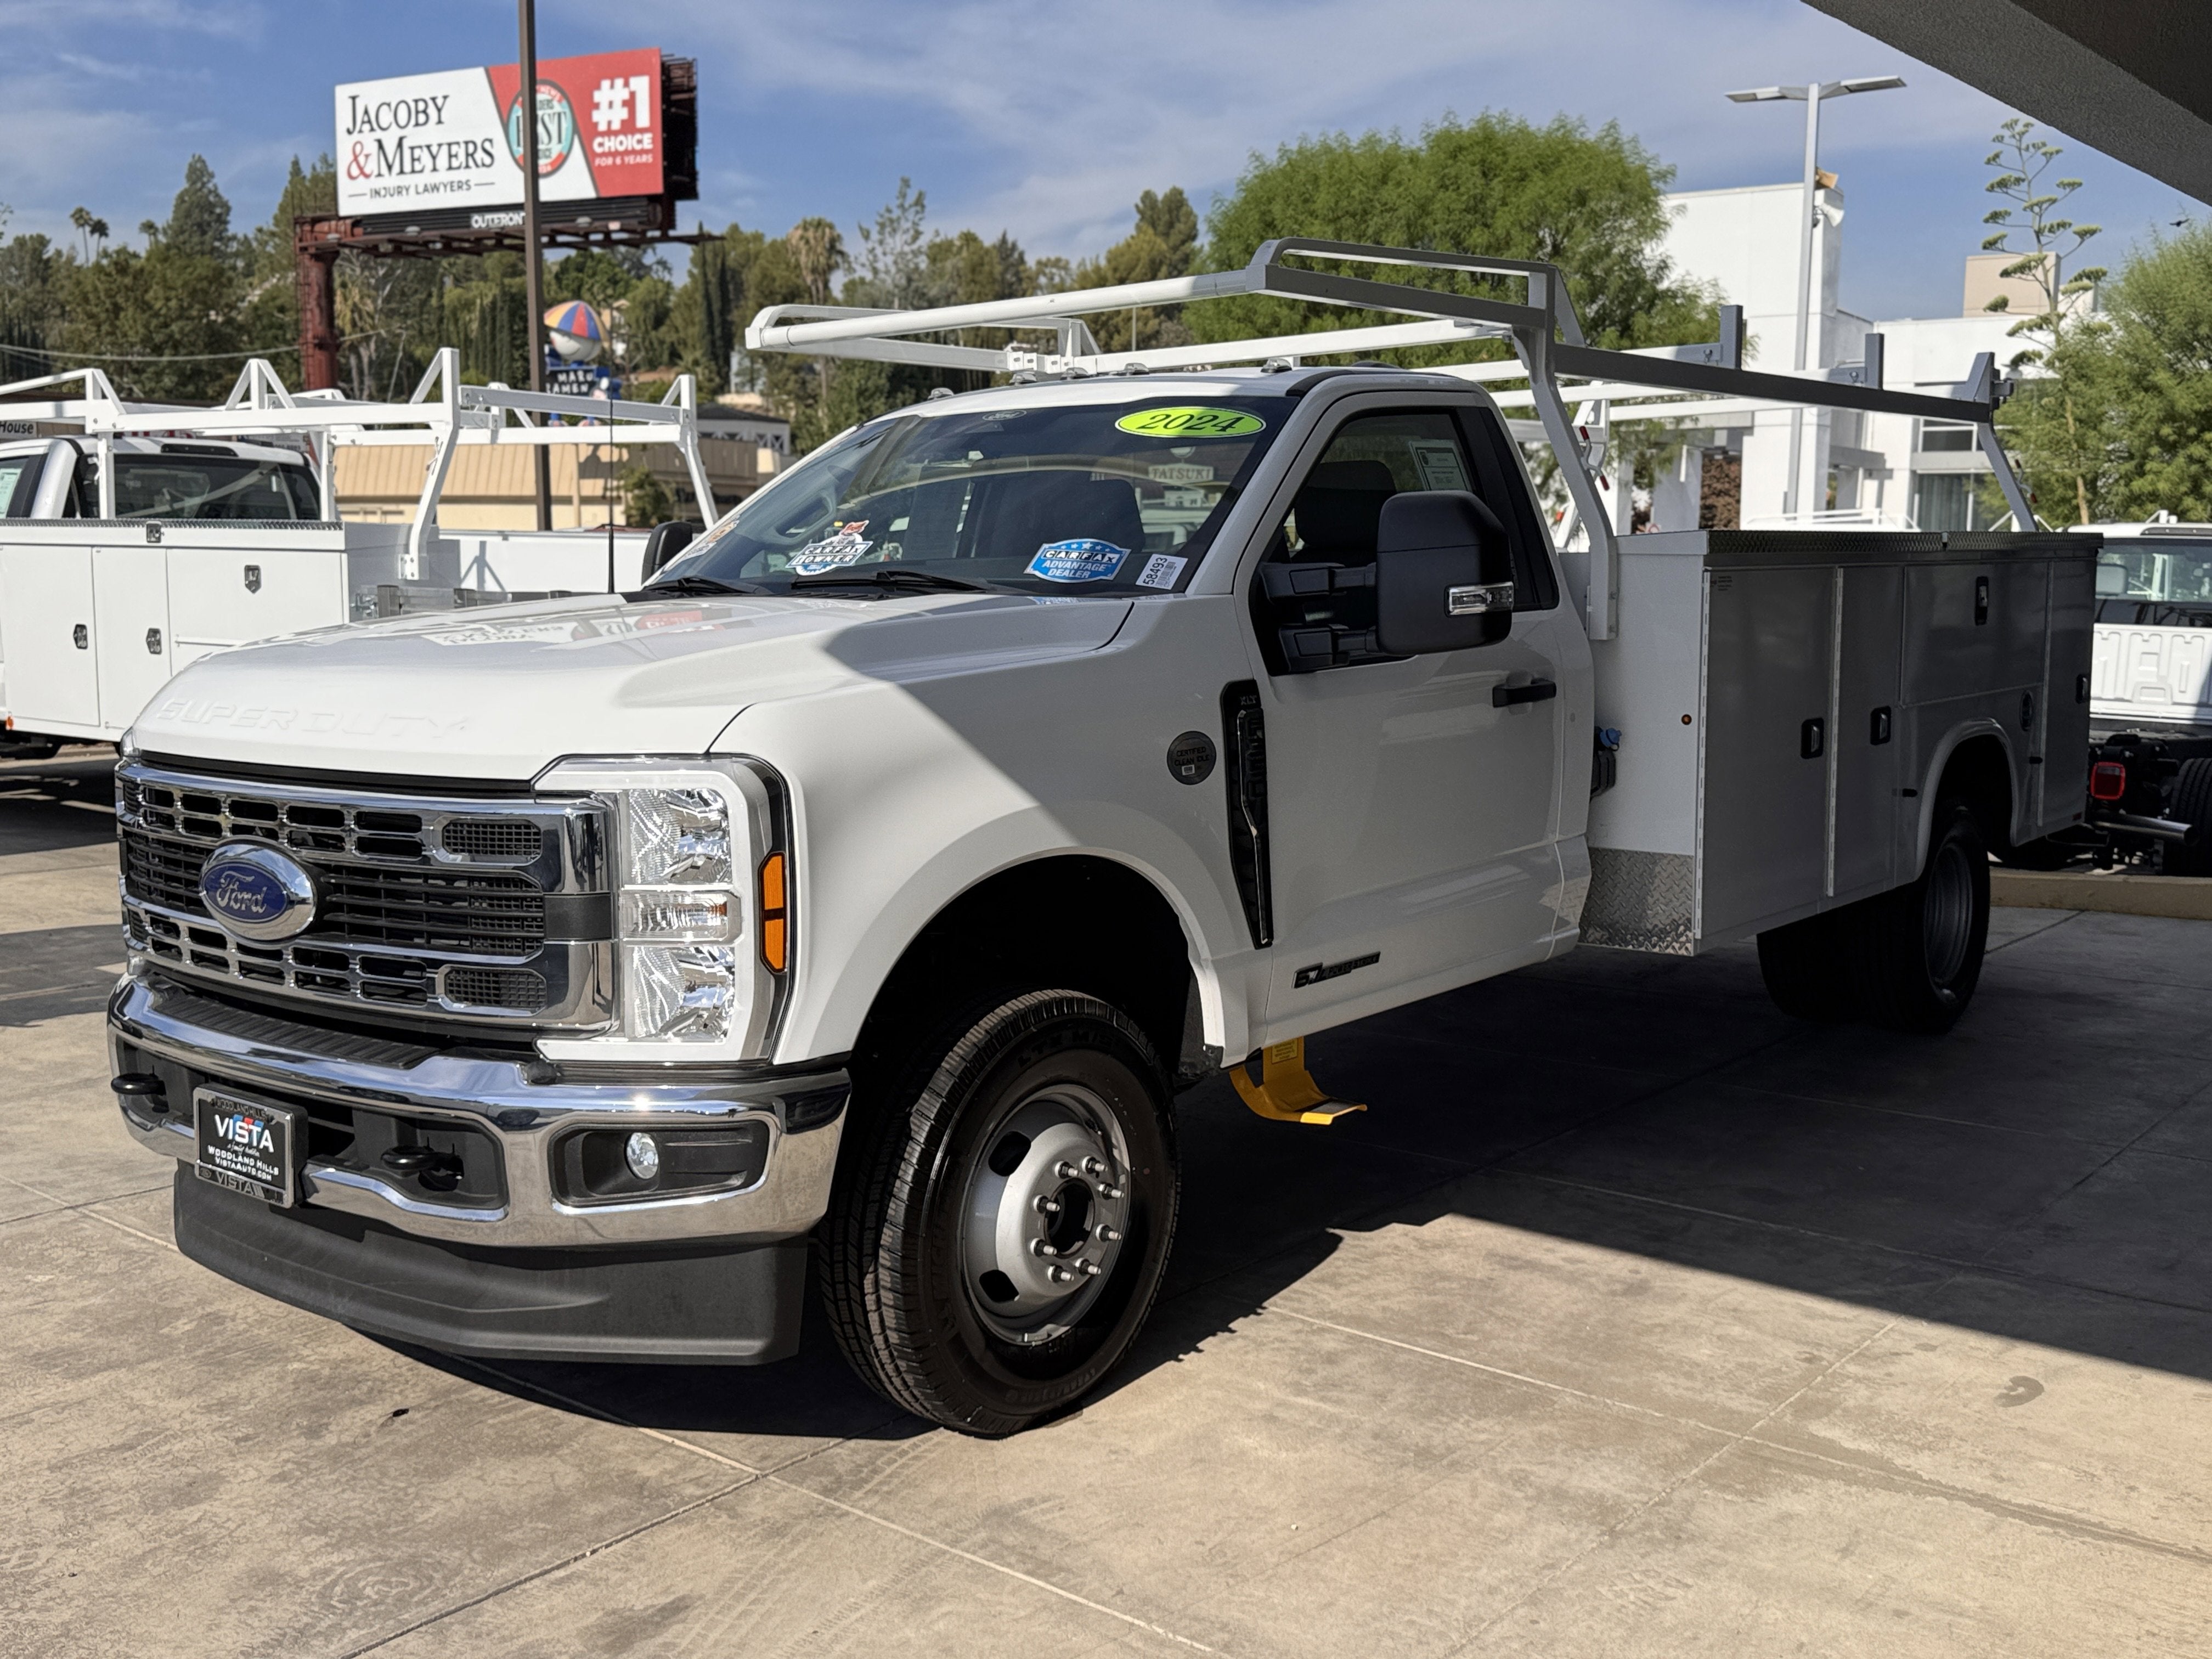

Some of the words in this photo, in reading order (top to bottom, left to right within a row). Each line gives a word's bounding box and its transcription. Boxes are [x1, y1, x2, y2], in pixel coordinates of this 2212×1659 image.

[592, 75, 650, 132] #1
[346, 94, 449, 136] JACOBY
[592, 132, 653, 154] CHOICE
[594, 156, 613, 167] FOR
[615, 155, 622, 165] 6
[624, 154, 653, 164] YEARS
[370, 184, 411, 199] INJURY
[415, 179, 472, 195] LAWYERS
[557, 370, 593, 382] MARU
[0, 421, 34, 434] House
[1136, 414, 1245, 432] 2024
[1152, 468, 1211, 480] TATSUKI
[804, 546, 862, 555] CARFAX
[1045, 550, 1117, 563] CARFAX
[1042, 560, 1107, 572] ADVANTAGE
[1047, 568, 1091, 578] DEALER
[1143, 557, 1167, 585] 58493
[155, 698, 299, 730] SUPER
[301, 711, 470, 739] DUTY
[216, 871, 268, 913] Ford
[215, 1114, 274, 1153] VISTA
[207, 1144, 255, 1166] WOODLAND
[256, 1159, 279, 1176] HILLS
[215, 1171, 256, 1195] VISTA
